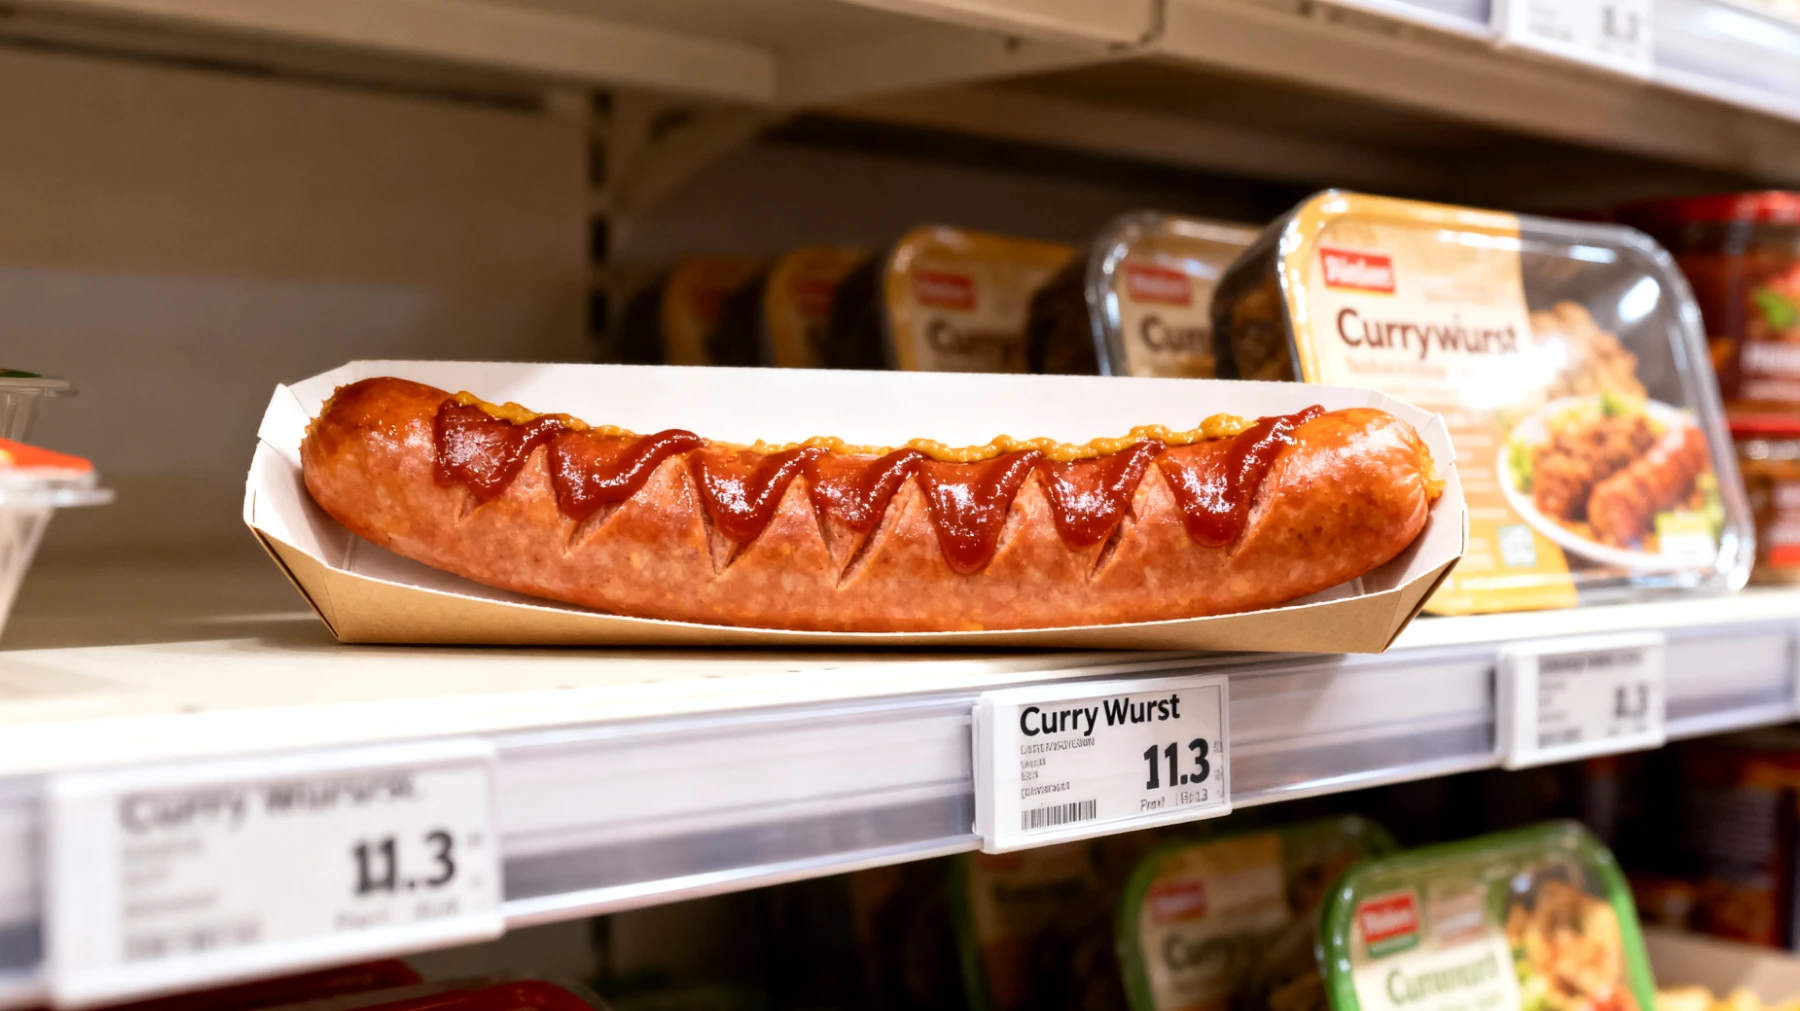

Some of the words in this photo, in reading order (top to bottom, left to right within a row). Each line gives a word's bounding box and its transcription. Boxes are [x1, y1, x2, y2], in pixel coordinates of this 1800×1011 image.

[1336, 306, 1518, 360] Currywurst
[1020, 706, 1099, 737] Curry
[1103, 694, 1181, 726] Wurst
[1143, 738, 1210, 791] 11.3
[351, 829, 456, 896] 11.3
